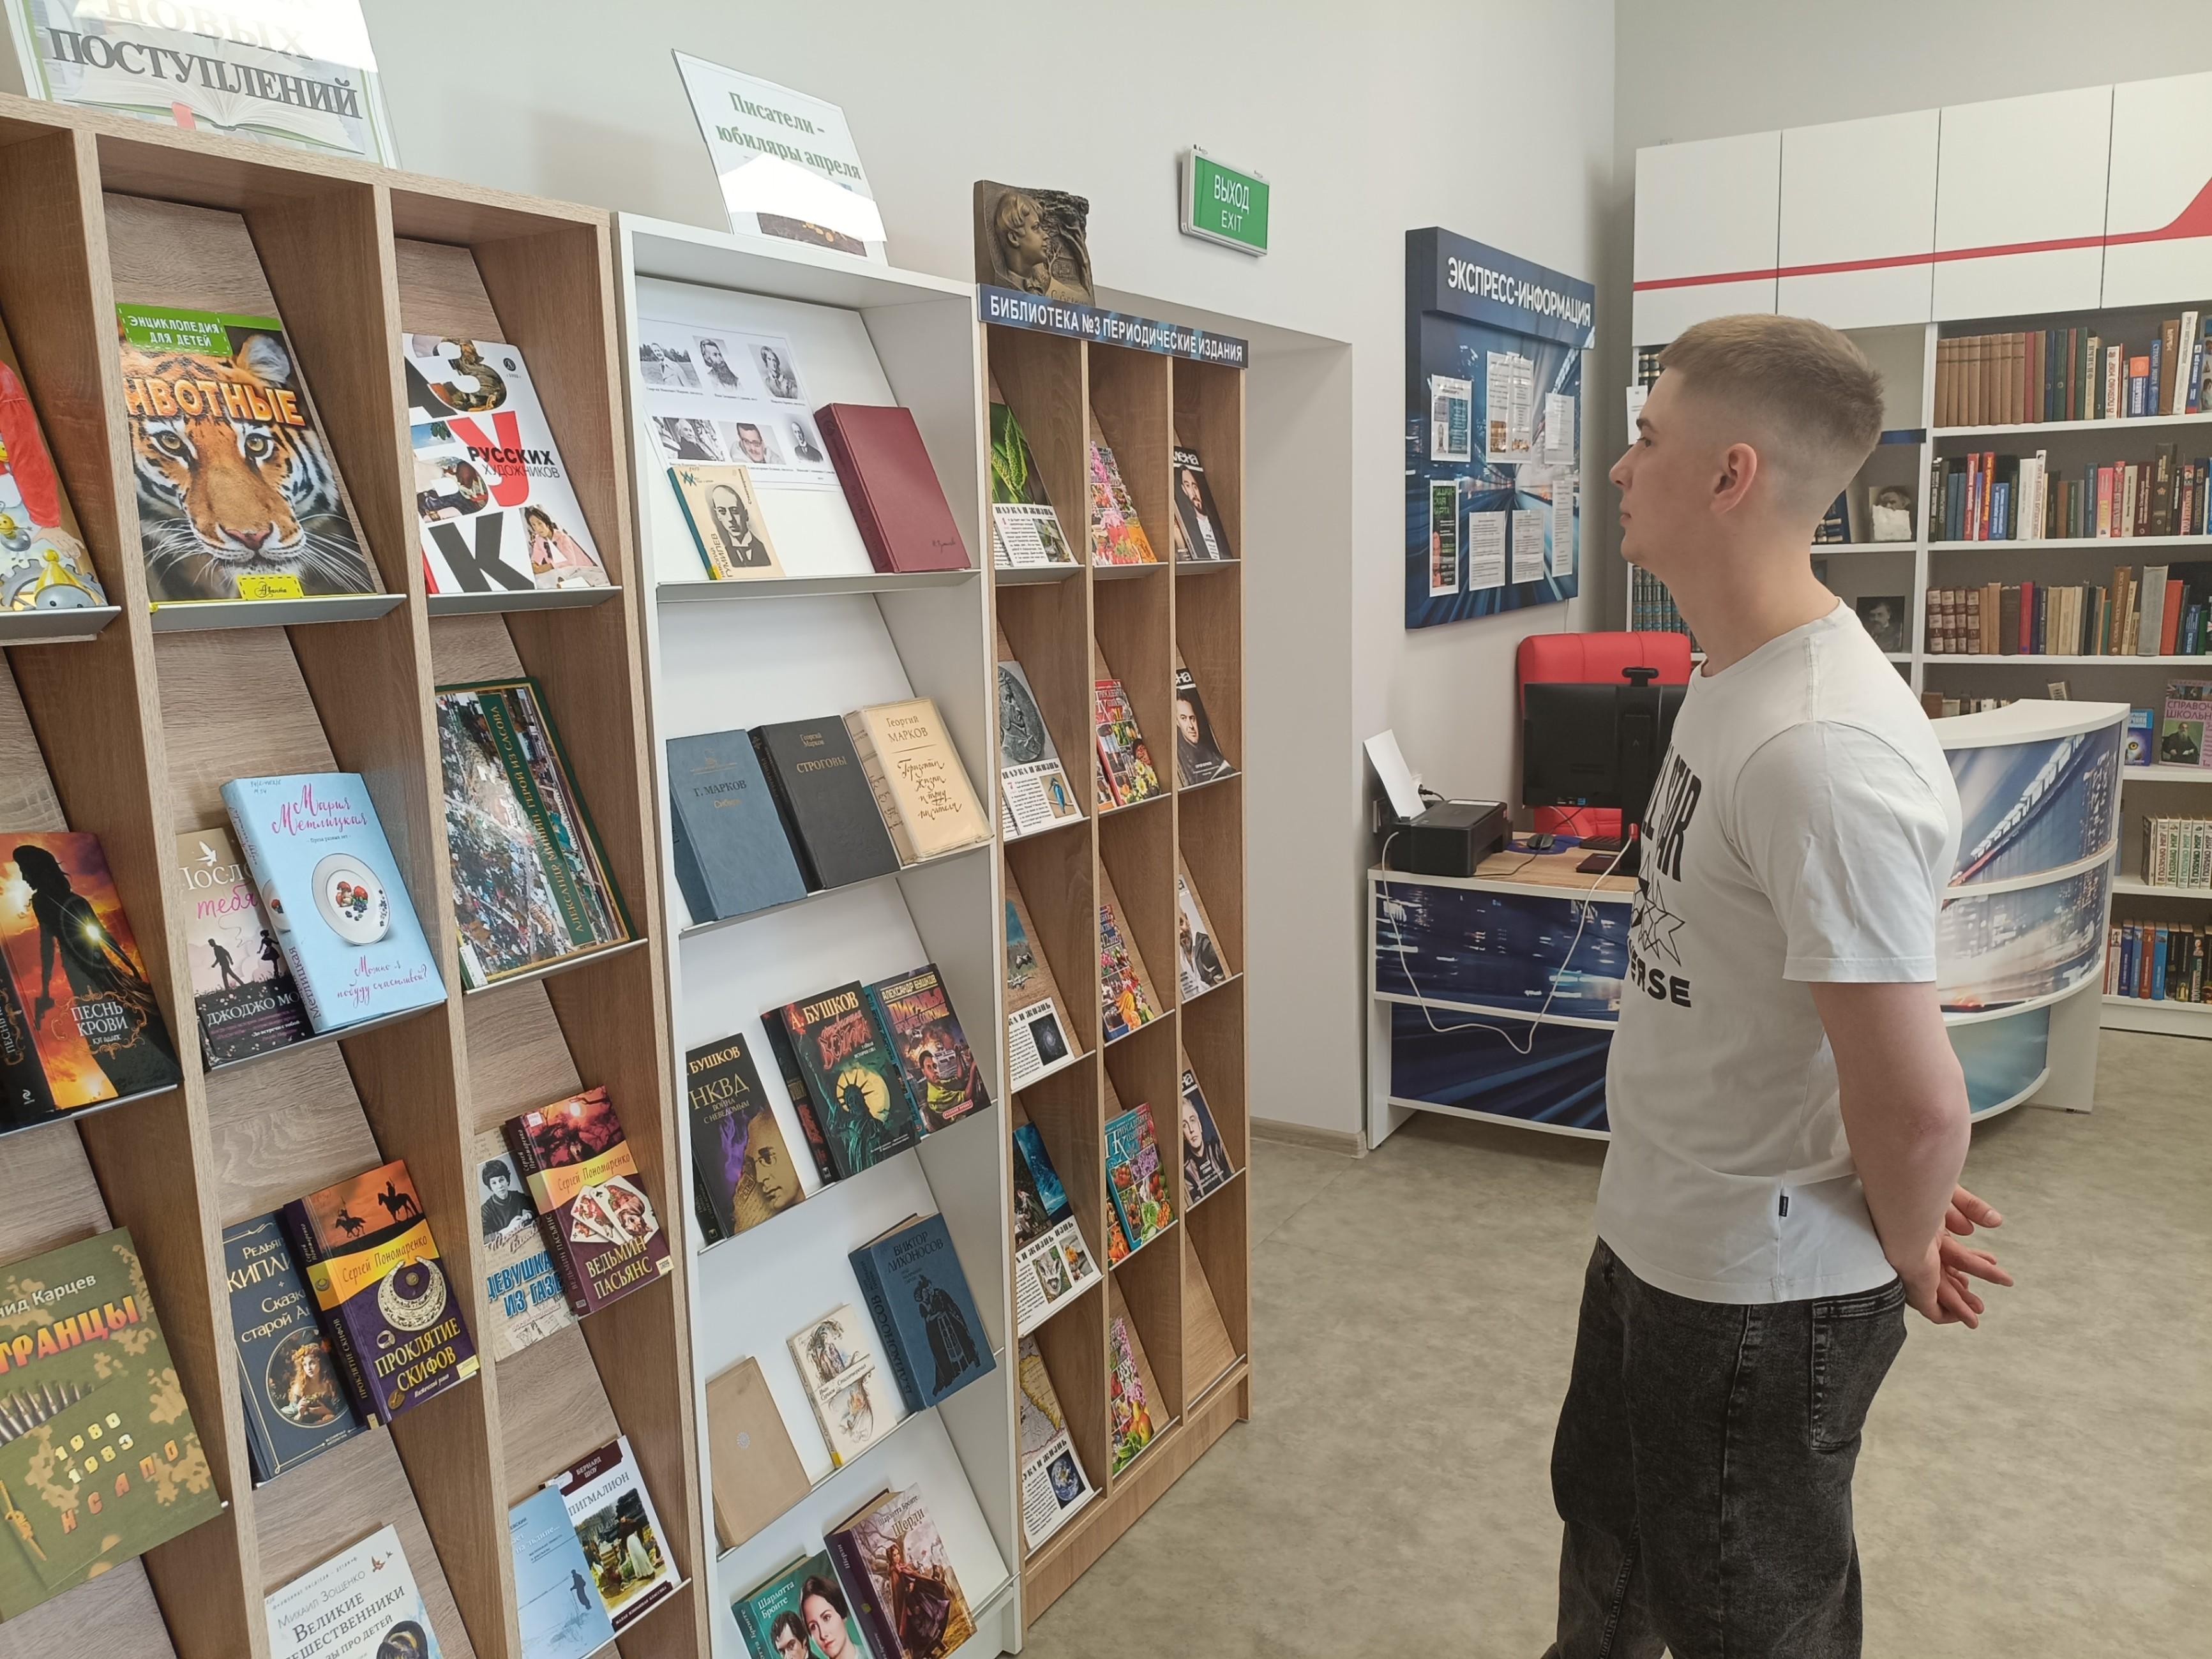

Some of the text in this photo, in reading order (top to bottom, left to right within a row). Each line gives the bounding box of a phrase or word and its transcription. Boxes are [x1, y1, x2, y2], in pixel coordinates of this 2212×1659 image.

[46, 27, 362, 119] ПОСТУПЛЕНИЙ
[728, 91, 815, 135] Писатели
[715, 125, 862, 180] юбиляры апреля
[1214, 174, 1249, 214] ВЫХОД
[1221, 210, 1242, 233] EXIT
[1448, 257, 1591, 329] ЭКСПРЕСС-ИНФОРМАЦИЯ
[128, 315, 220, 334] ЭНЦИКЛОПЕДИЯ
[149, 332, 212, 348] ДЛЯ ДЕТЕЙ
[990, 295, 1243, 362] БИБЛИОТЕКА №3 ПЕРИОДИЧЕСКИЕ ИЗДАНИЯ
[125, 378, 306, 426] ИВОТНЫЕ
[467, 446, 555, 466] РУССКИХ
[483, 463, 561, 479] ХУДОЖНИКОВ
[1029, 507, 1053, 516] ЖИЗНЬ
[711, 533, 734, 577] ГУМИЛЕВ
[886, 715, 919, 728] Георгий
[2166, 709, 2212, 720] ШКОЛЬН
[2167, 701, 2212, 710] СПРАВОЧ
[490, 705, 513, 752] САСОВА
[800, 732, 823, 742] Георгий
[802, 737, 825, 748] Марков
[888, 726, 928, 743] МАРКОВ
[509, 753, 520, 770] ИЗ
[796, 755, 847, 774] СТРОГОВЫ
[1035, 761, 1059, 772] ЖИЗНЬ
[293, 783, 351, 818] Мария
[514, 772, 534, 809] ГЕРОЙ
[694, 779, 747, 797] Г. МАРКОВ
[271, 800, 368, 836] Метлицкая
[2192, 850, 2200, 877] ПОЗНАЮ
[197, 881, 259, 920] тебя
[553, 864, 584, 933] АЛЕКСАНДР
[287, 945, 322, 1020] Метлицкая
[337, 963, 428, 1009] побуду счастливой?
[882, 973, 937, 1001] АЛЕКСАНДР БУШКОВ
[71, 1000, 124, 1022] ПЕСНЬ
[206, 996, 276, 1028] ДЖОДЖО
[791, 991, 859, 1030] А. БУШКОВ
[887, 987, 945, 1025] ПИРАНЬЯ
[77, 1015, 128, 1037] КРОВИ
[689, 1046, 741, 1074] БУШКОВ
[689, 1073, 750, 1110] НКВД
[712, 1097, 735, 1111] ВОЙНА
[709, 1100, 750, 1122] НЕВЕДОМЫМ
[557, 1152, 631, 1196] Сергей Пономаренко
[894, 1230, 929, 1257] ВИКТОР
[1055, 1222, 1074, 1237] ИЗНЬ
[342, 1235, 428, 1283] Сергей Пономаренко
[546, 1213, 578, 1291] ВЕДЬМИН ПАСЬЯНС
[585, 1235, 647, 1279] ВЕДЬМИН
[887, 1237, 944, 1274] ЛИХОНОСОВ
[32, 1274, 97, 1304] Карцев
[487, 1250, 554, 1302] ДЕВУШКА
[593, 1256, 653, 1300] ПАСЬЯНС
[504, 1271, 564, 1319] ИЗ ГАЗЕ
[241, 1312, 293, 1343] старой
[333, 1317, 368, 1399] ПРОКЛЯТИЕ СКИФОВ
[374, 1317, 461, 1379] ПРОКЛЯТИЕ
[396, 1347, 457, 1393] СКИФОВ
[576, 1455, 602, 1476] БЕРНАРД
[584, 1466, 599, 1479] ШОУ
[568, 1471, 630, 1517] ПИГМАЛИОН
[877, 1495, 919, 1528] Шарлотта Бронте
[277, 1570, 366, 1630] МИХАИЛ ЗОЩЕНКО
[758, 1580, 795, 1610] Шарлотта
[760, 1596, 789, 1619] Бронте
[292, 1592, 365, 1644] ВЕЛИКИЕ
[342, 1614, 394, 1654] ПРО ДЕТЕЙ
[741, 1609, 756, 1640] Бронте
